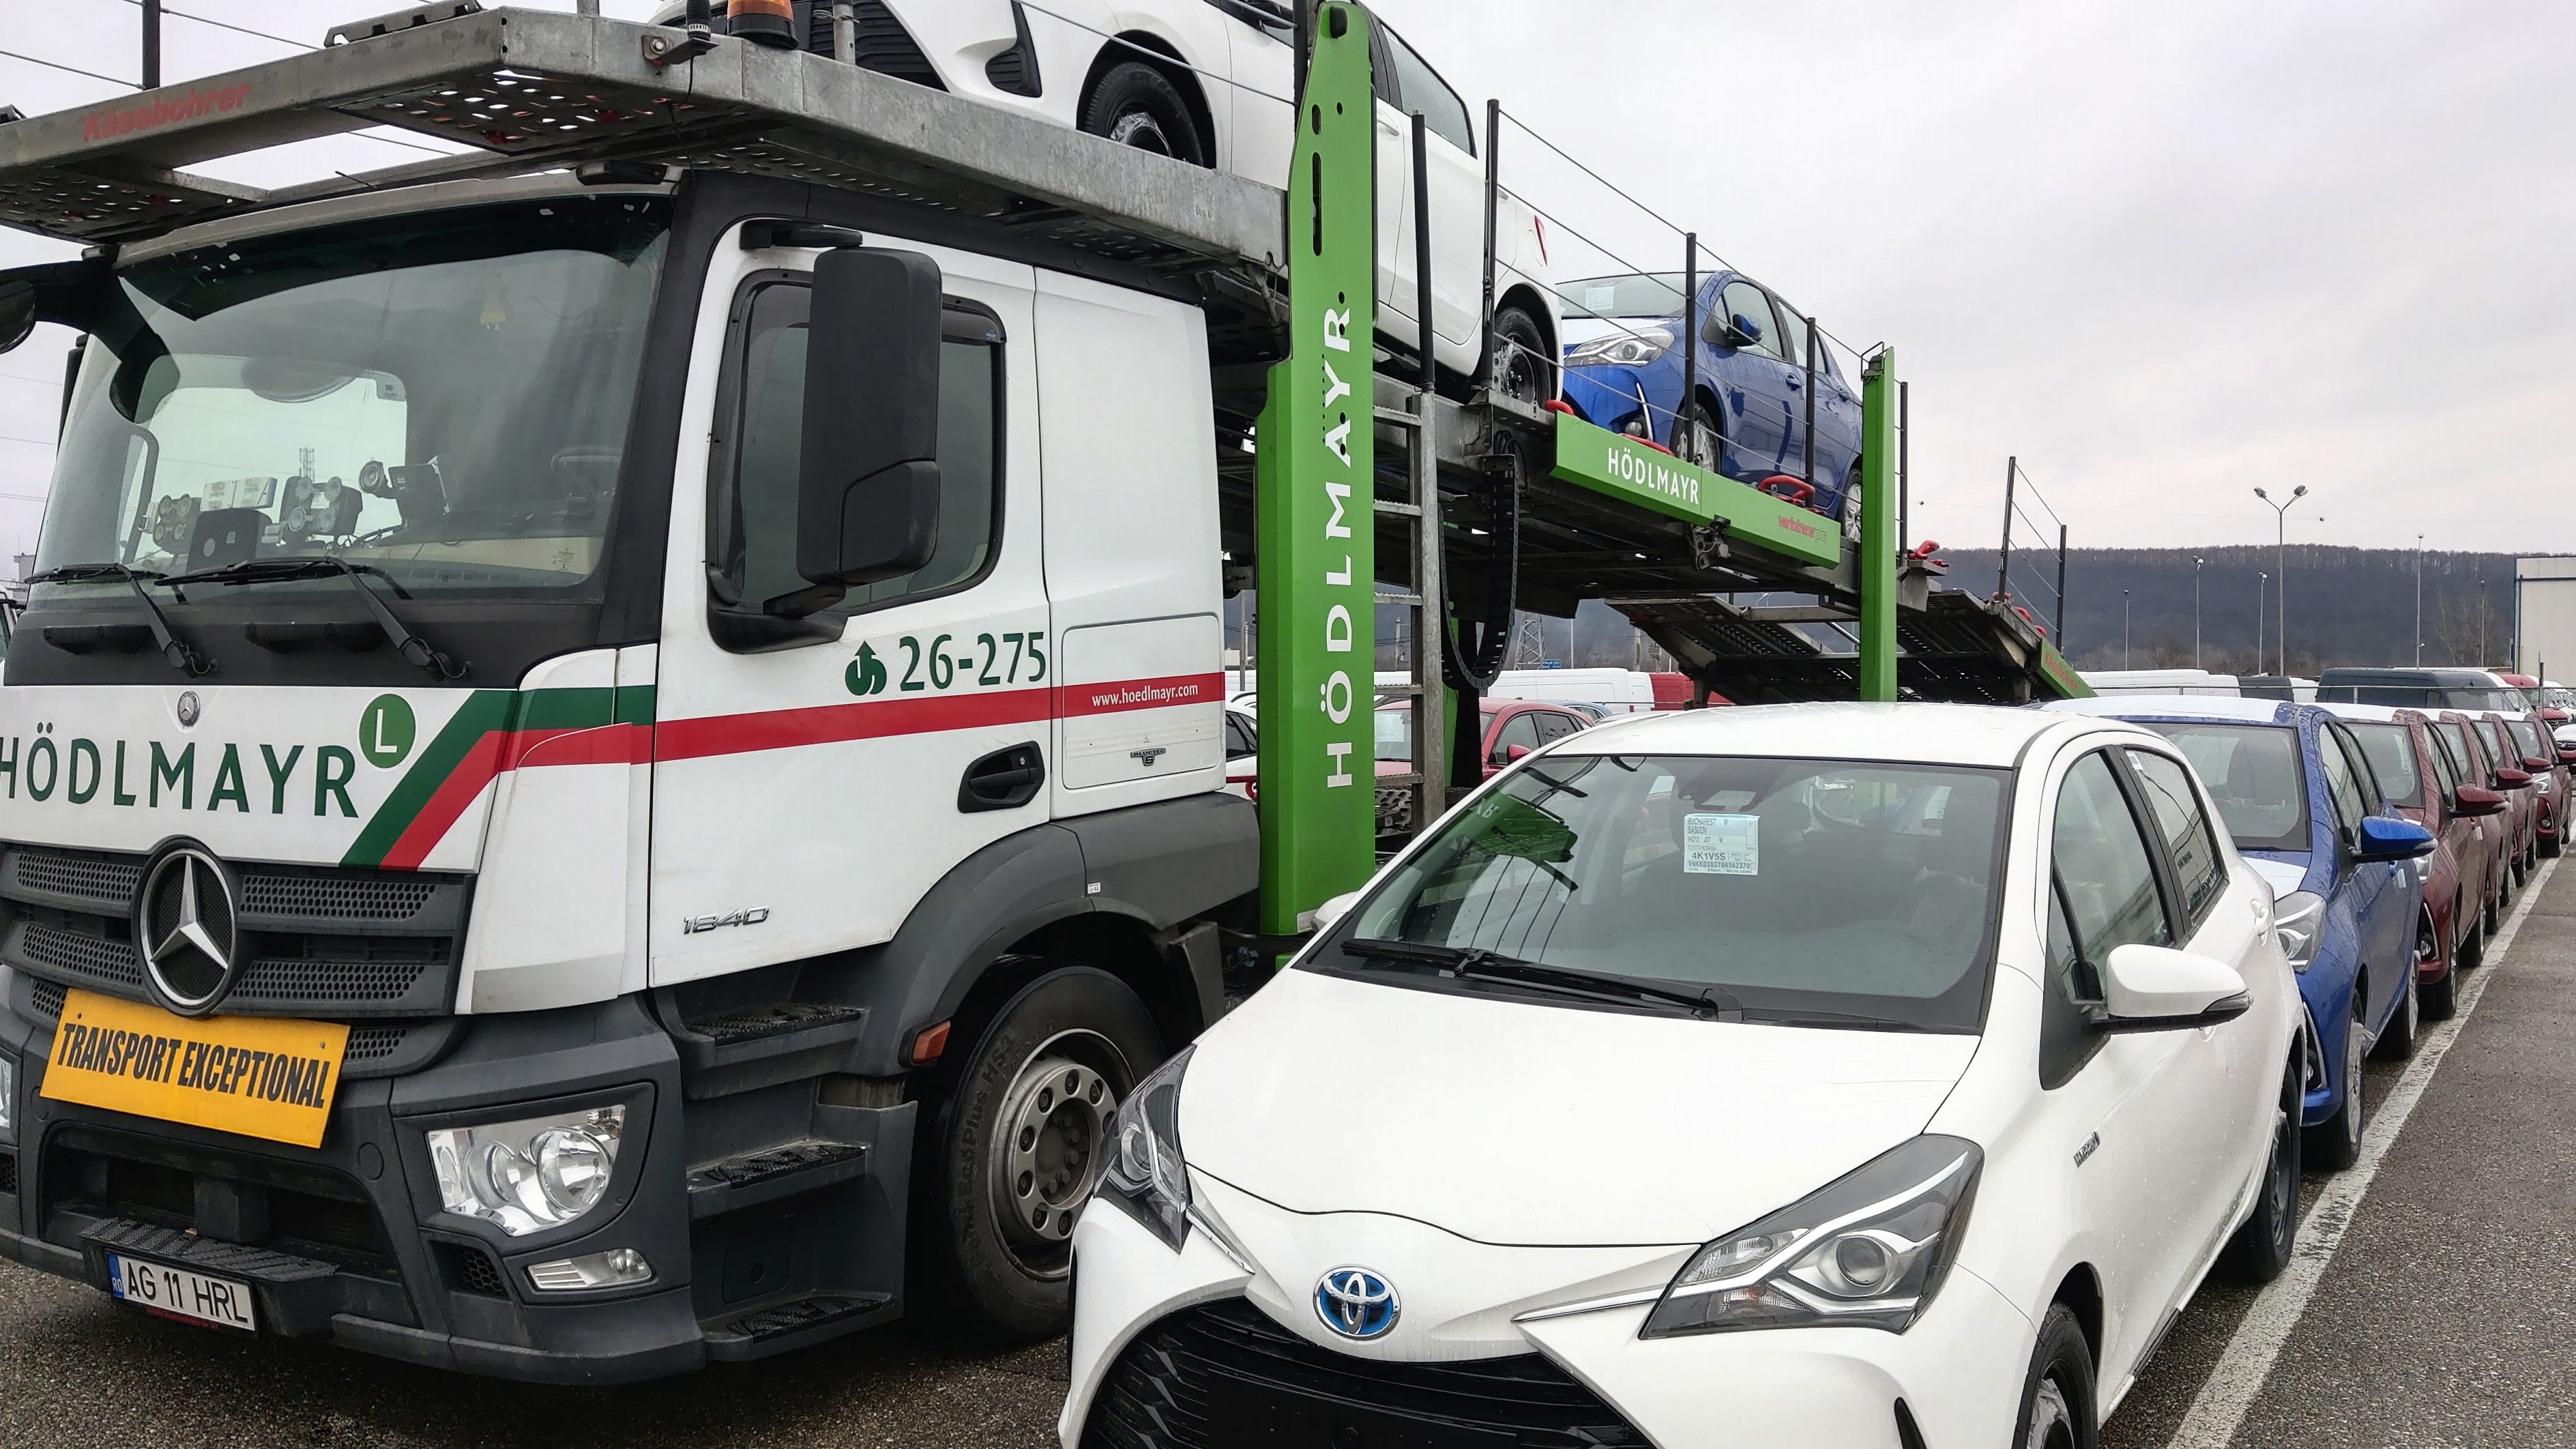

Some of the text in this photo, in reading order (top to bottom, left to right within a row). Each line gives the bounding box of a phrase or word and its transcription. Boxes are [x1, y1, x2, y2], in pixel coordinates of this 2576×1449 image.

[83, 85, 251, 143] Kässbohrer
[1607, 447, 1699, 506] HÖDLMAYR
[1320, 308, 1352, 788] HÖDLMAYR
[898, 631, 1046, 692] 26-275
[1092, 683, 1199, 707] www.hoedlmayr.com
[0, 721, 359, 819] HÖDLMAYR
[1133, 748, 1165, 757] BLUETEC
[1692, 851, 1726, 860] 4K1V5S
[684, 905, 770, 935] 1840
[57, 1023, 331, 1109] TRANSPORT EXCEPTIONAL
[112, 1277, 123, 1292] RO
[128, 1261, 156, 1300] AG
[163, 1270, 184, 1309] 11
[191, 1276, 249, 1323] HRL
